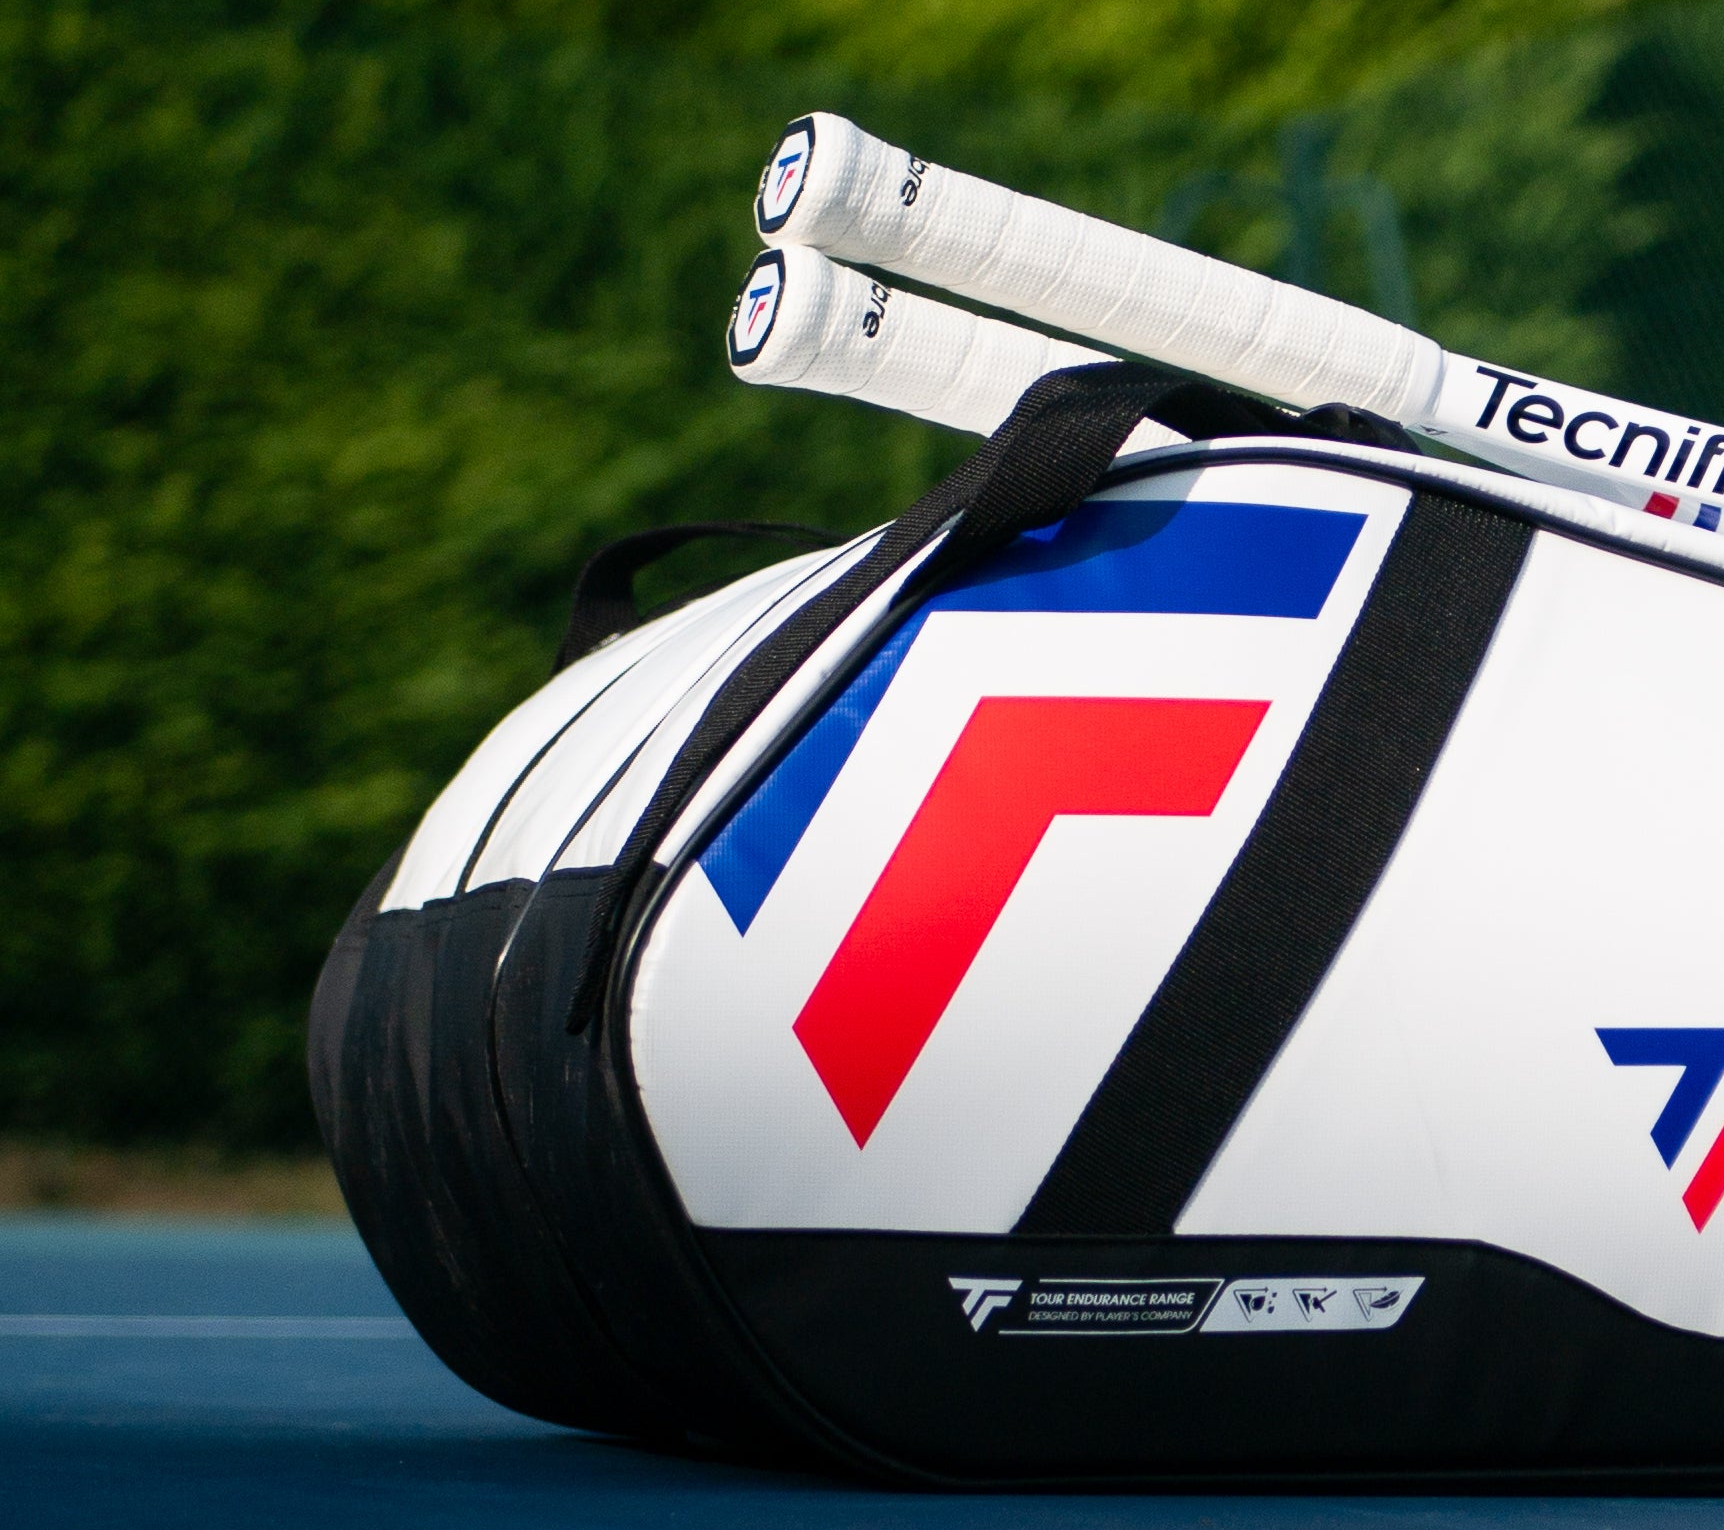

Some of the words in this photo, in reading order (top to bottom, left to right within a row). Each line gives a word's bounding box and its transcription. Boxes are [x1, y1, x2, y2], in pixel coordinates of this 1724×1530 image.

[1030, 1292, 1066, 1305] TOUR
[1066, 1293, 1148, 1306] ENDURANCE
[1149, 1292, 1196, 1305] RANGE
[1028, 1310, 1079, 1321] DESIGNED
[1080, 1310, 1095, 1321] BY
[1140, 1310, 1194, 1321] COMPANY
